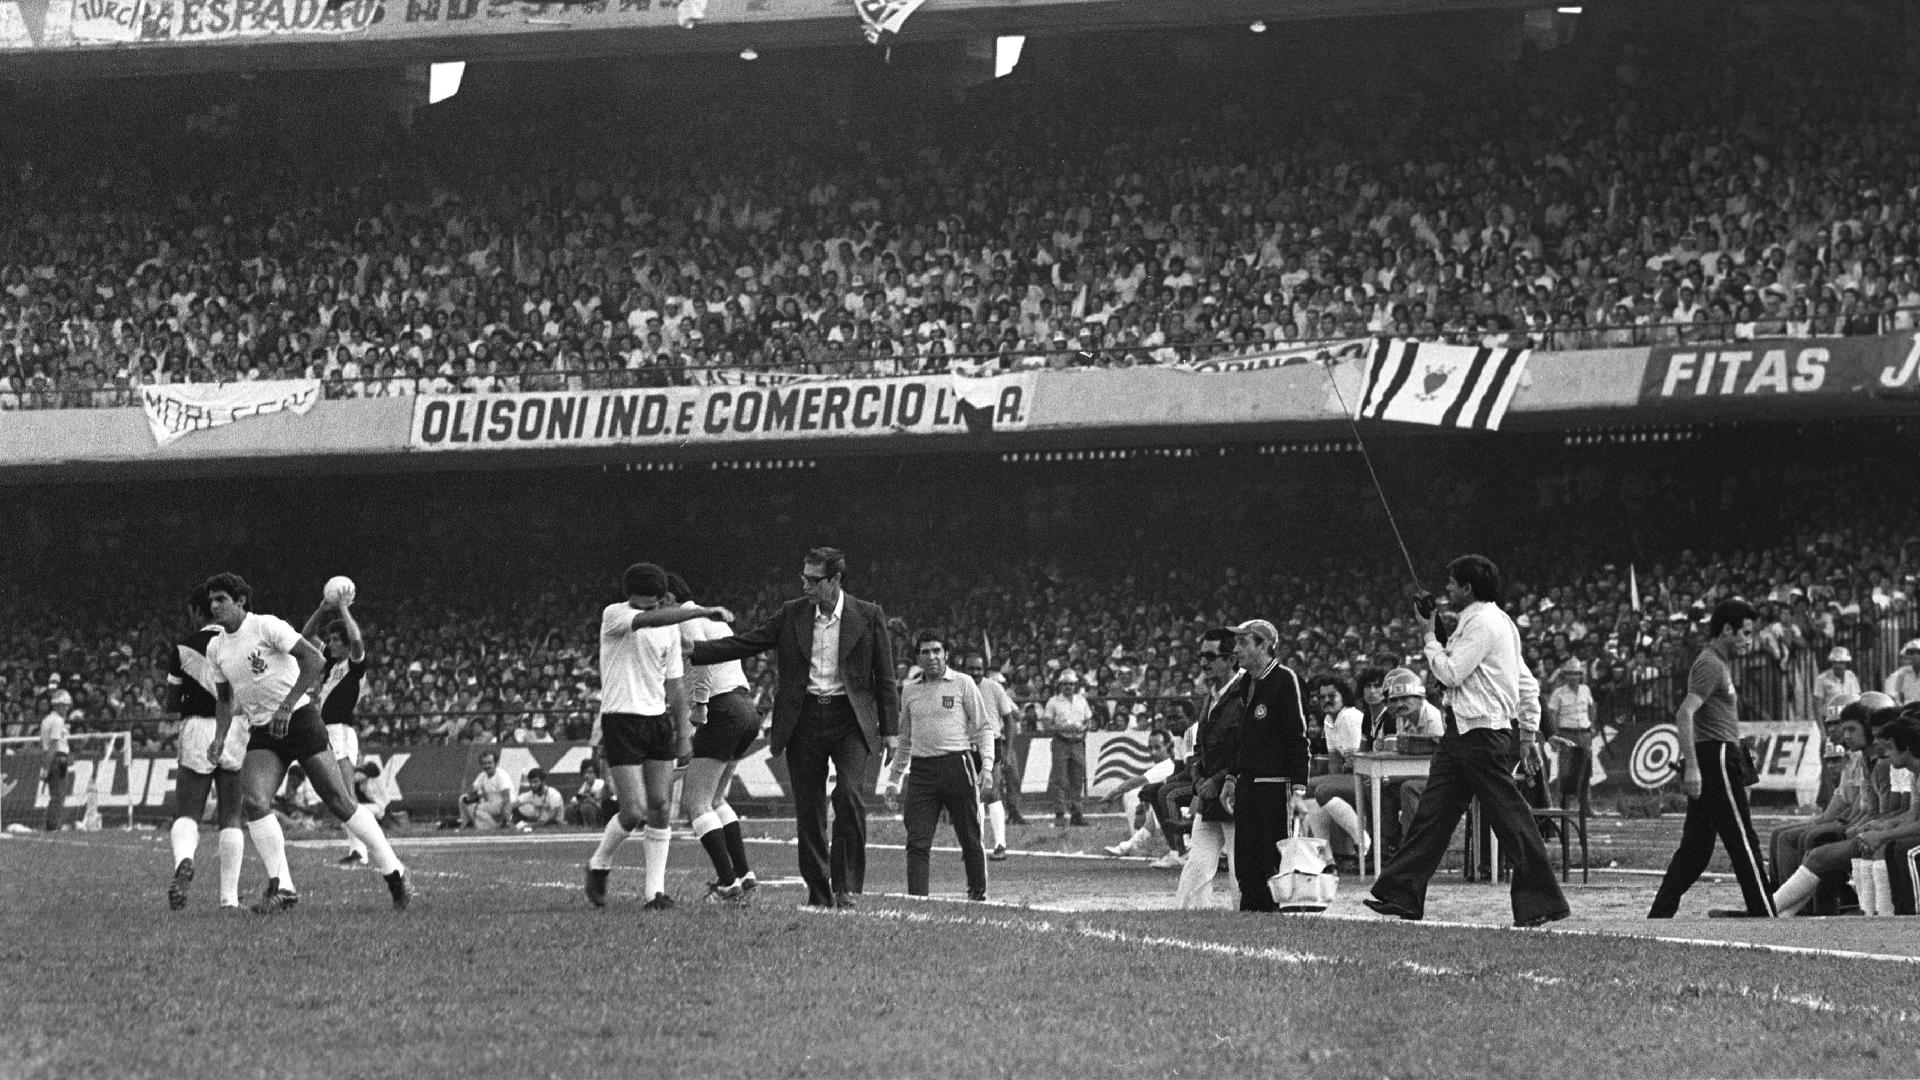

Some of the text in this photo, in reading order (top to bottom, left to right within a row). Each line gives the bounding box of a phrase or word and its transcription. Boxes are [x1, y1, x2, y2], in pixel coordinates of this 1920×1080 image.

[1660, 347, 1830, 396] FITAS
[421, 397, 589, 443] OLISONI
[703, 382, 926, 434] COMERCIO
